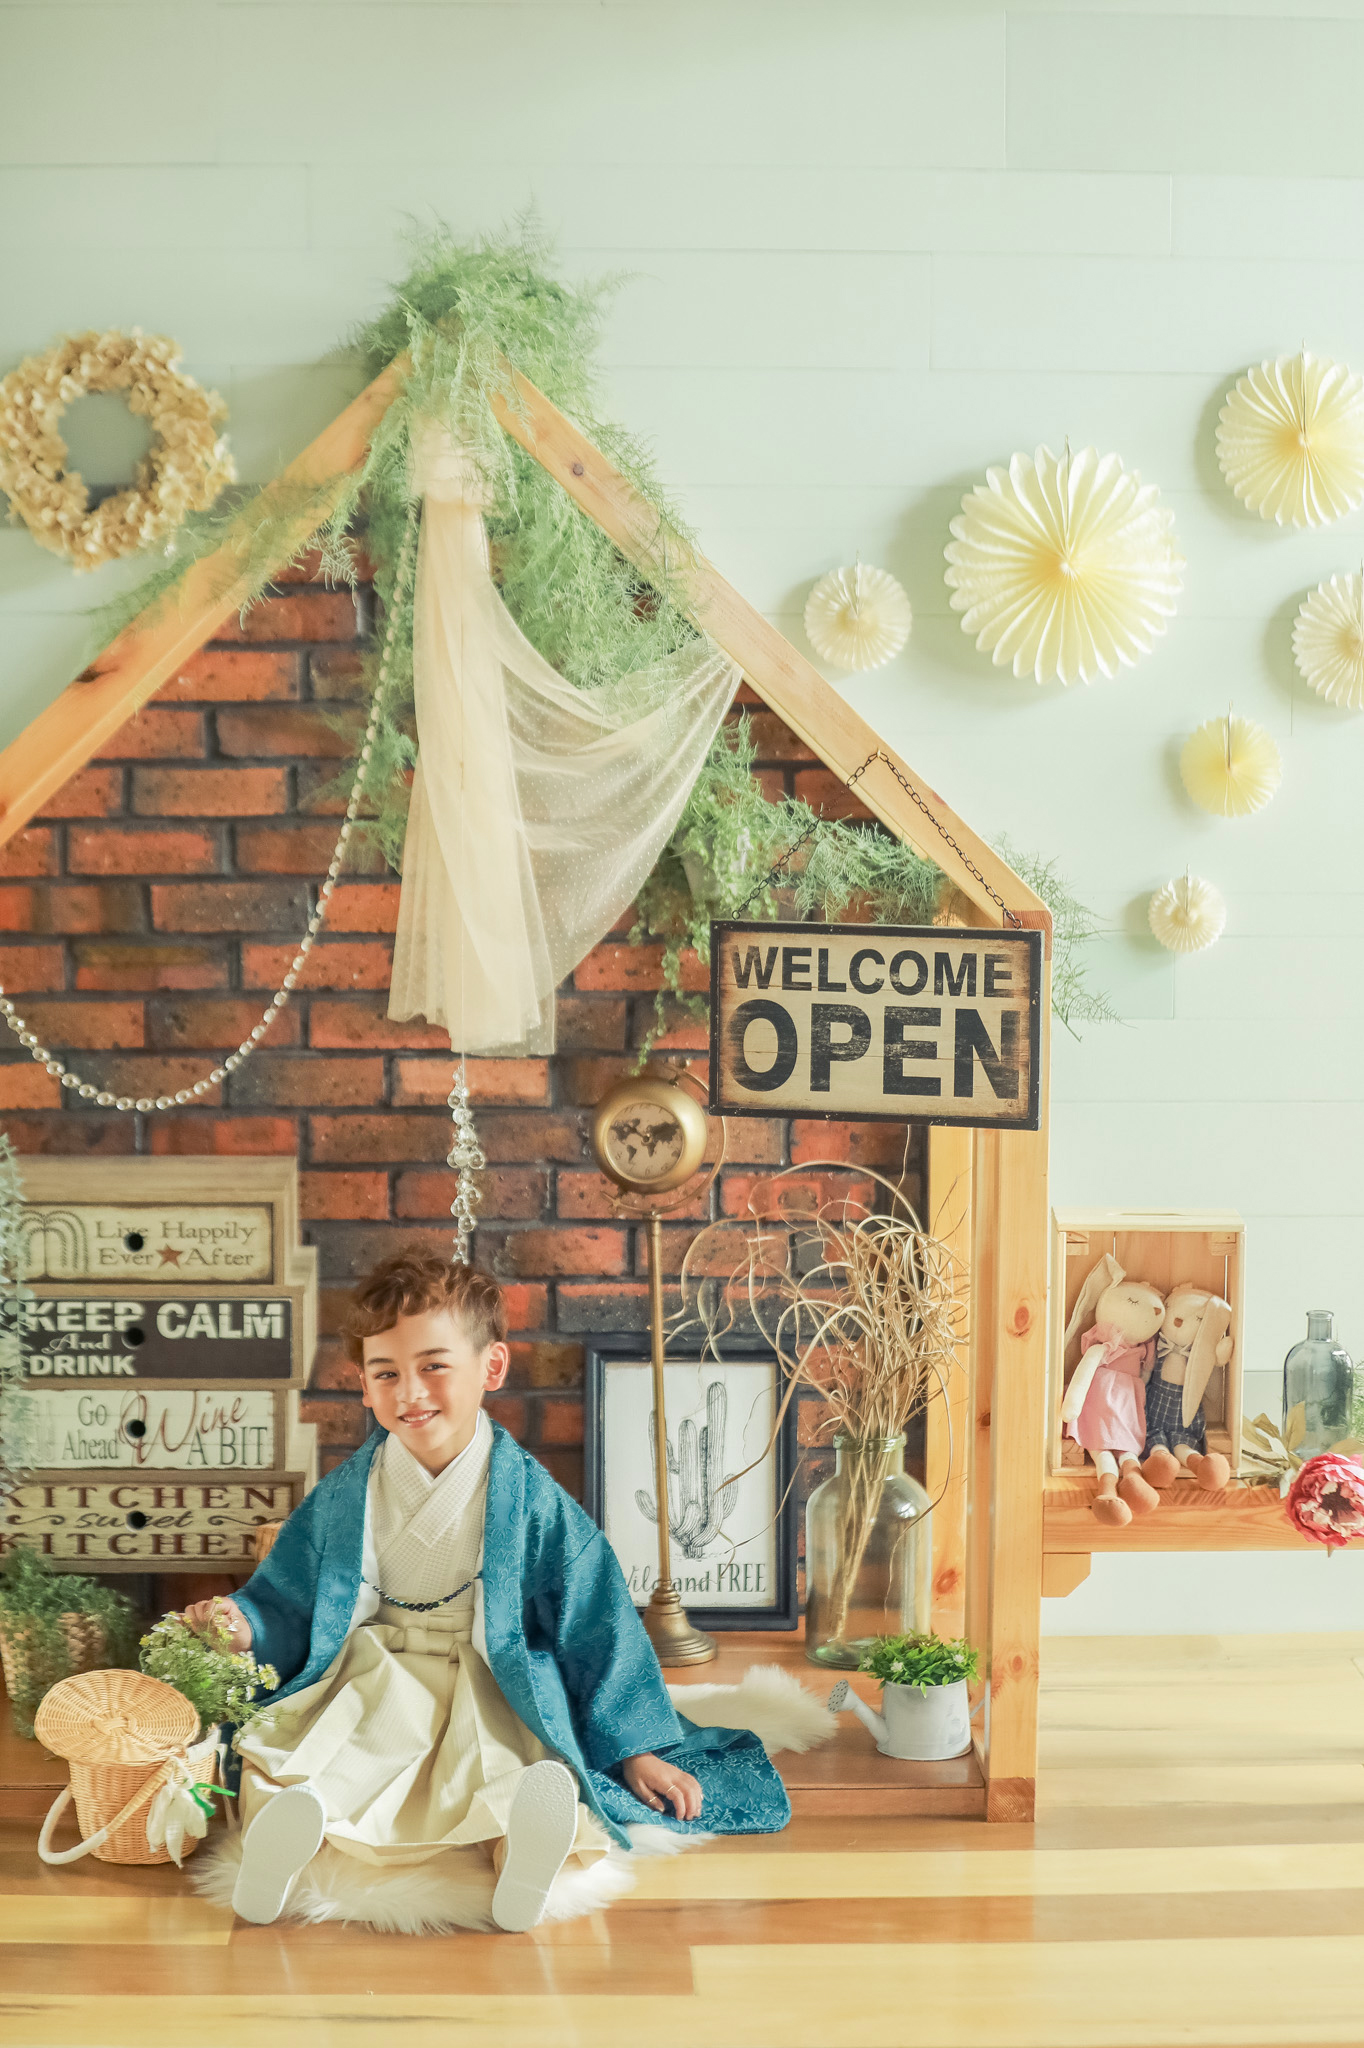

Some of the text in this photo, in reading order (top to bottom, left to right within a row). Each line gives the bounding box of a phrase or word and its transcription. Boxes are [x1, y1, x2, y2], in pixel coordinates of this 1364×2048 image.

[731, 945, 1015, 998] WELCOME
[728, 998, 1022, 1099] OPEN
[160, 1221, 256, 1244] Happily
[98, 1248, 254, 1266] Ever After
[25, 1301, 283, 1340] KEEP CALM
[41, 1332, 111, 1355] And
[29, 1354, 137, 1376] DRINK
[77, 1396, 108, 1426] Go
[118, 1389, 249, 1464] Wine
[62, 1429, 119, 1460] Ahead
[186, 1426, 268, 1466] A BIT
[672, 1570, 710, 1592] and
[716, 1563, 766, 1592] FREE
